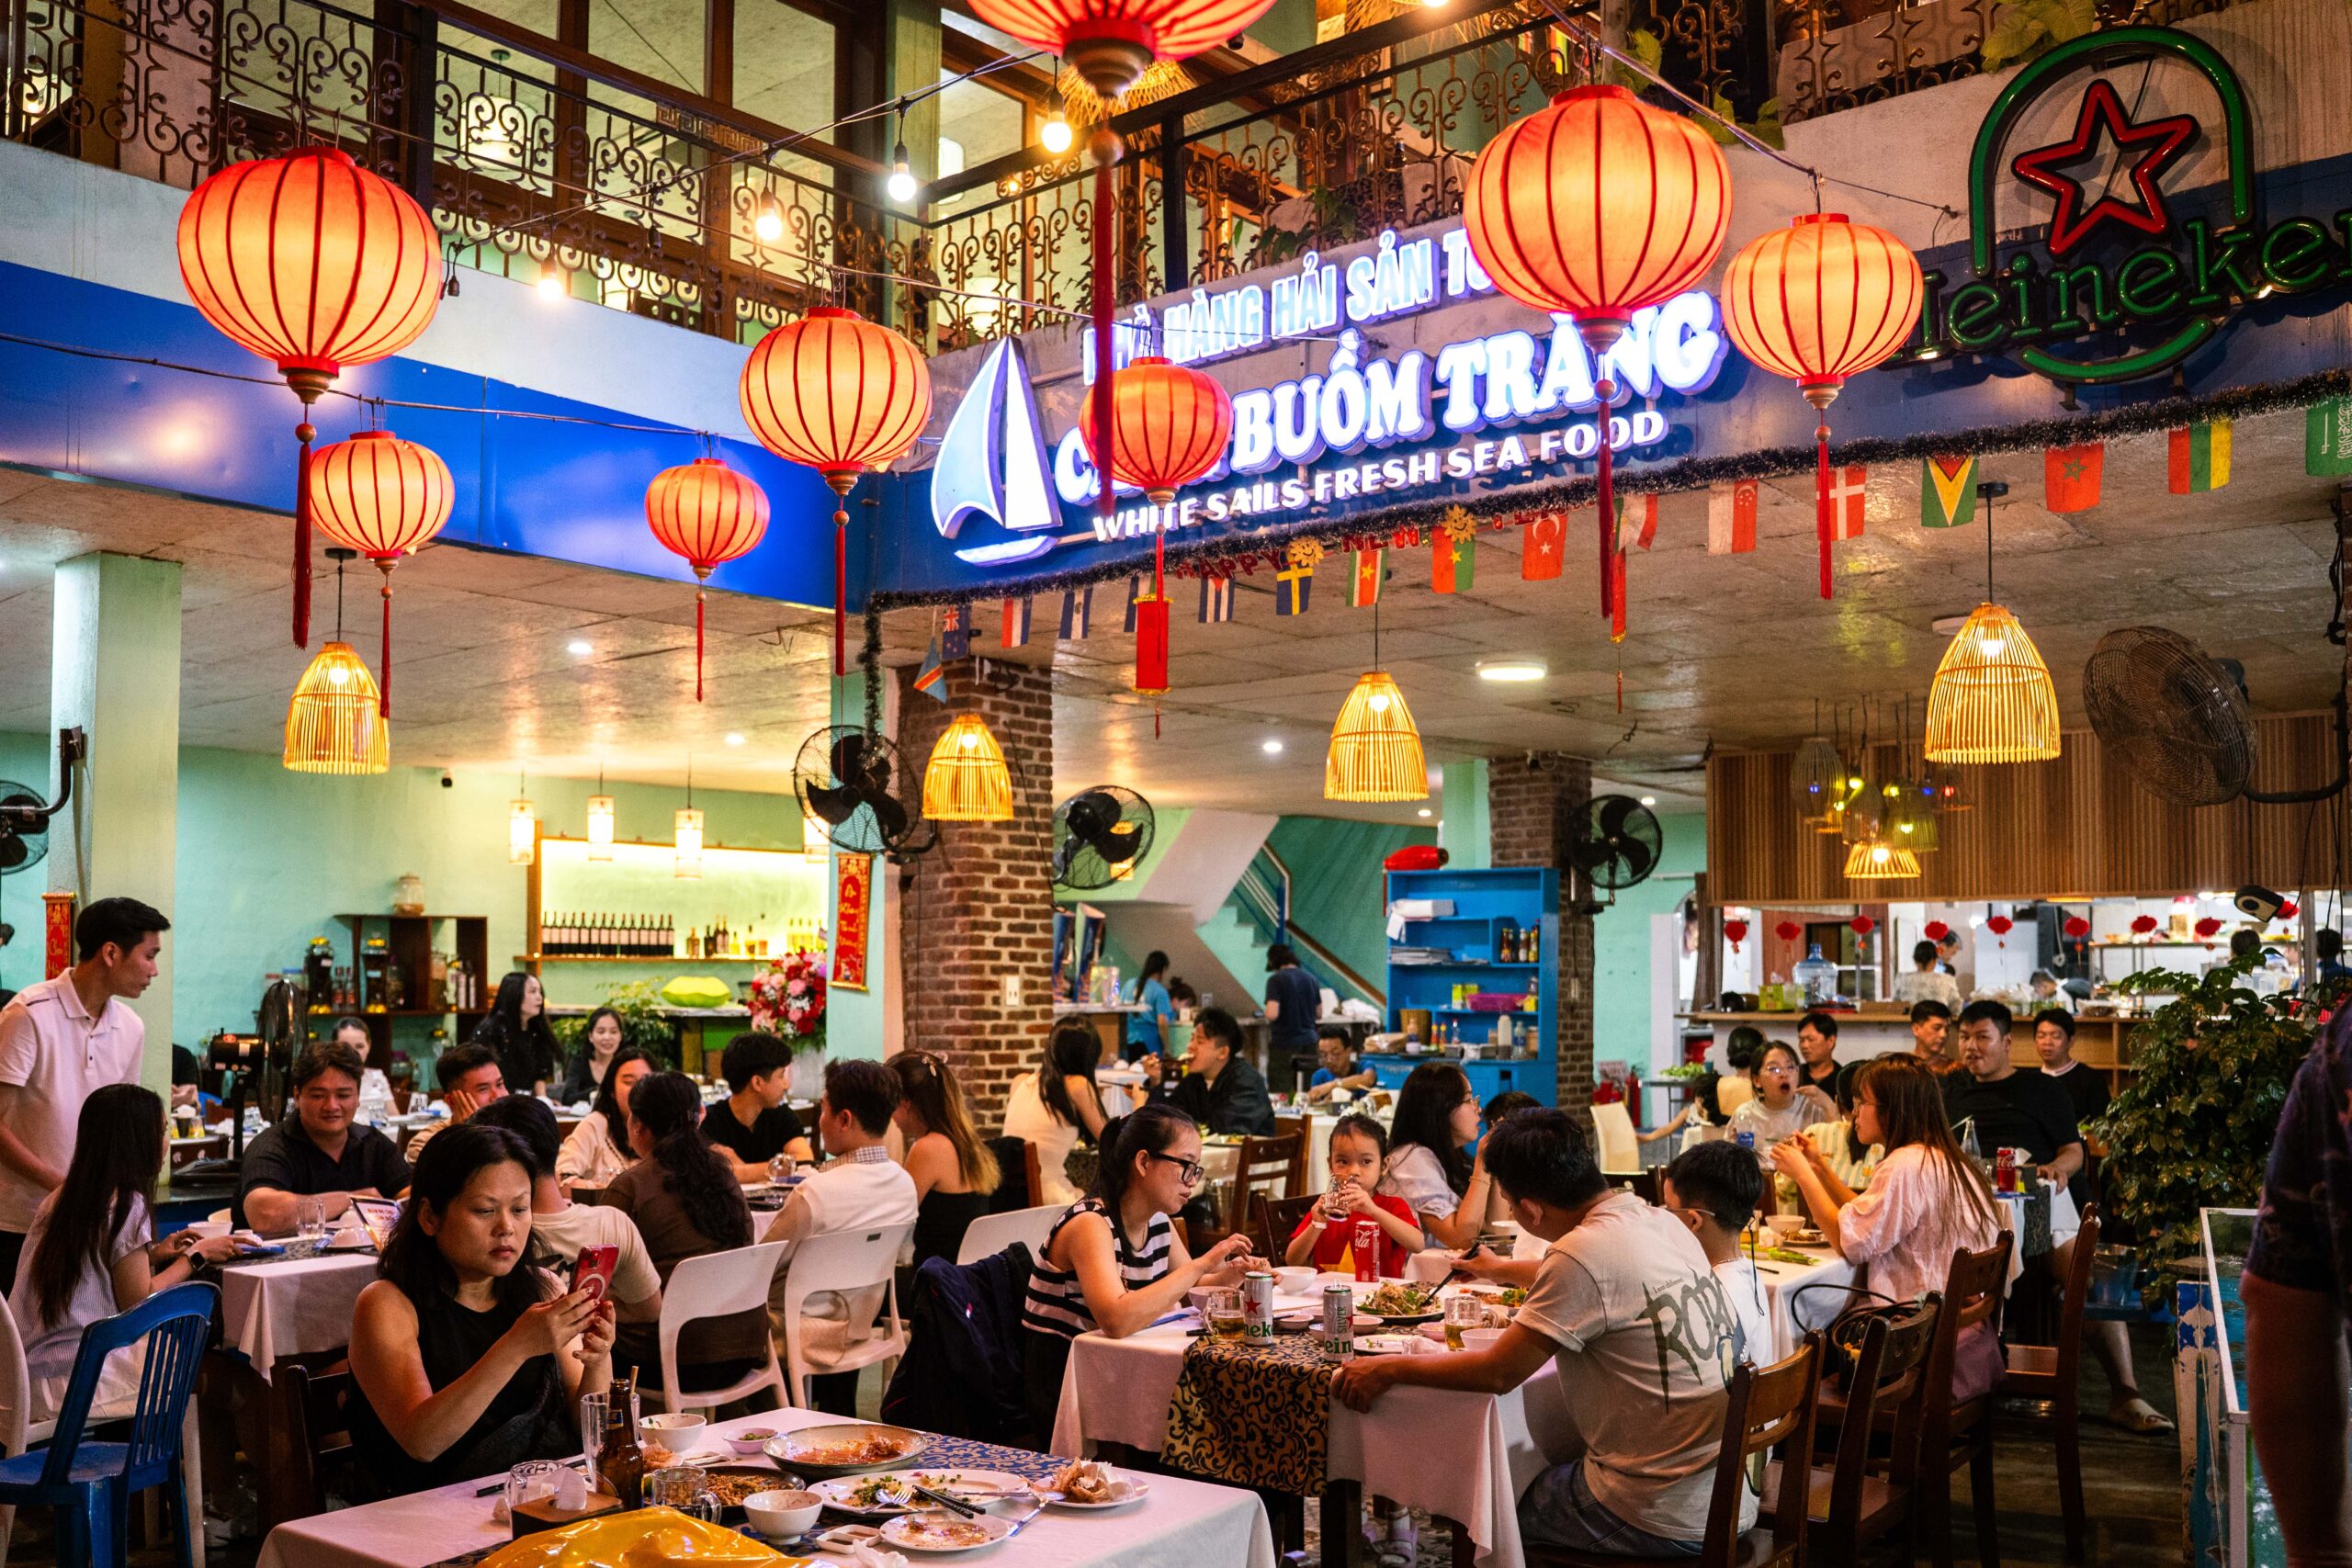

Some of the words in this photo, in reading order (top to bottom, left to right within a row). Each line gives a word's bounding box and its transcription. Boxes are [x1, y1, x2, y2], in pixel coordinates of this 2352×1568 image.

[1164, 287, 1264, 364] HÀNG
[1271, 250, 1338, 340] HẢI
[1346, 229, 1433, 322] SẢN
[1890, 209, 2352, 361] eineke
[1092, 497, 1197, 542] WHITE
[1206, 479, 1306, 521] SAILS
[1315, 452, 1438, 502] FRESH
[1447, 435, 1526, 478] SEA
[1541, 411, 1666, 461] FOOD
[1324, 1337, 1353, 1354] ein
